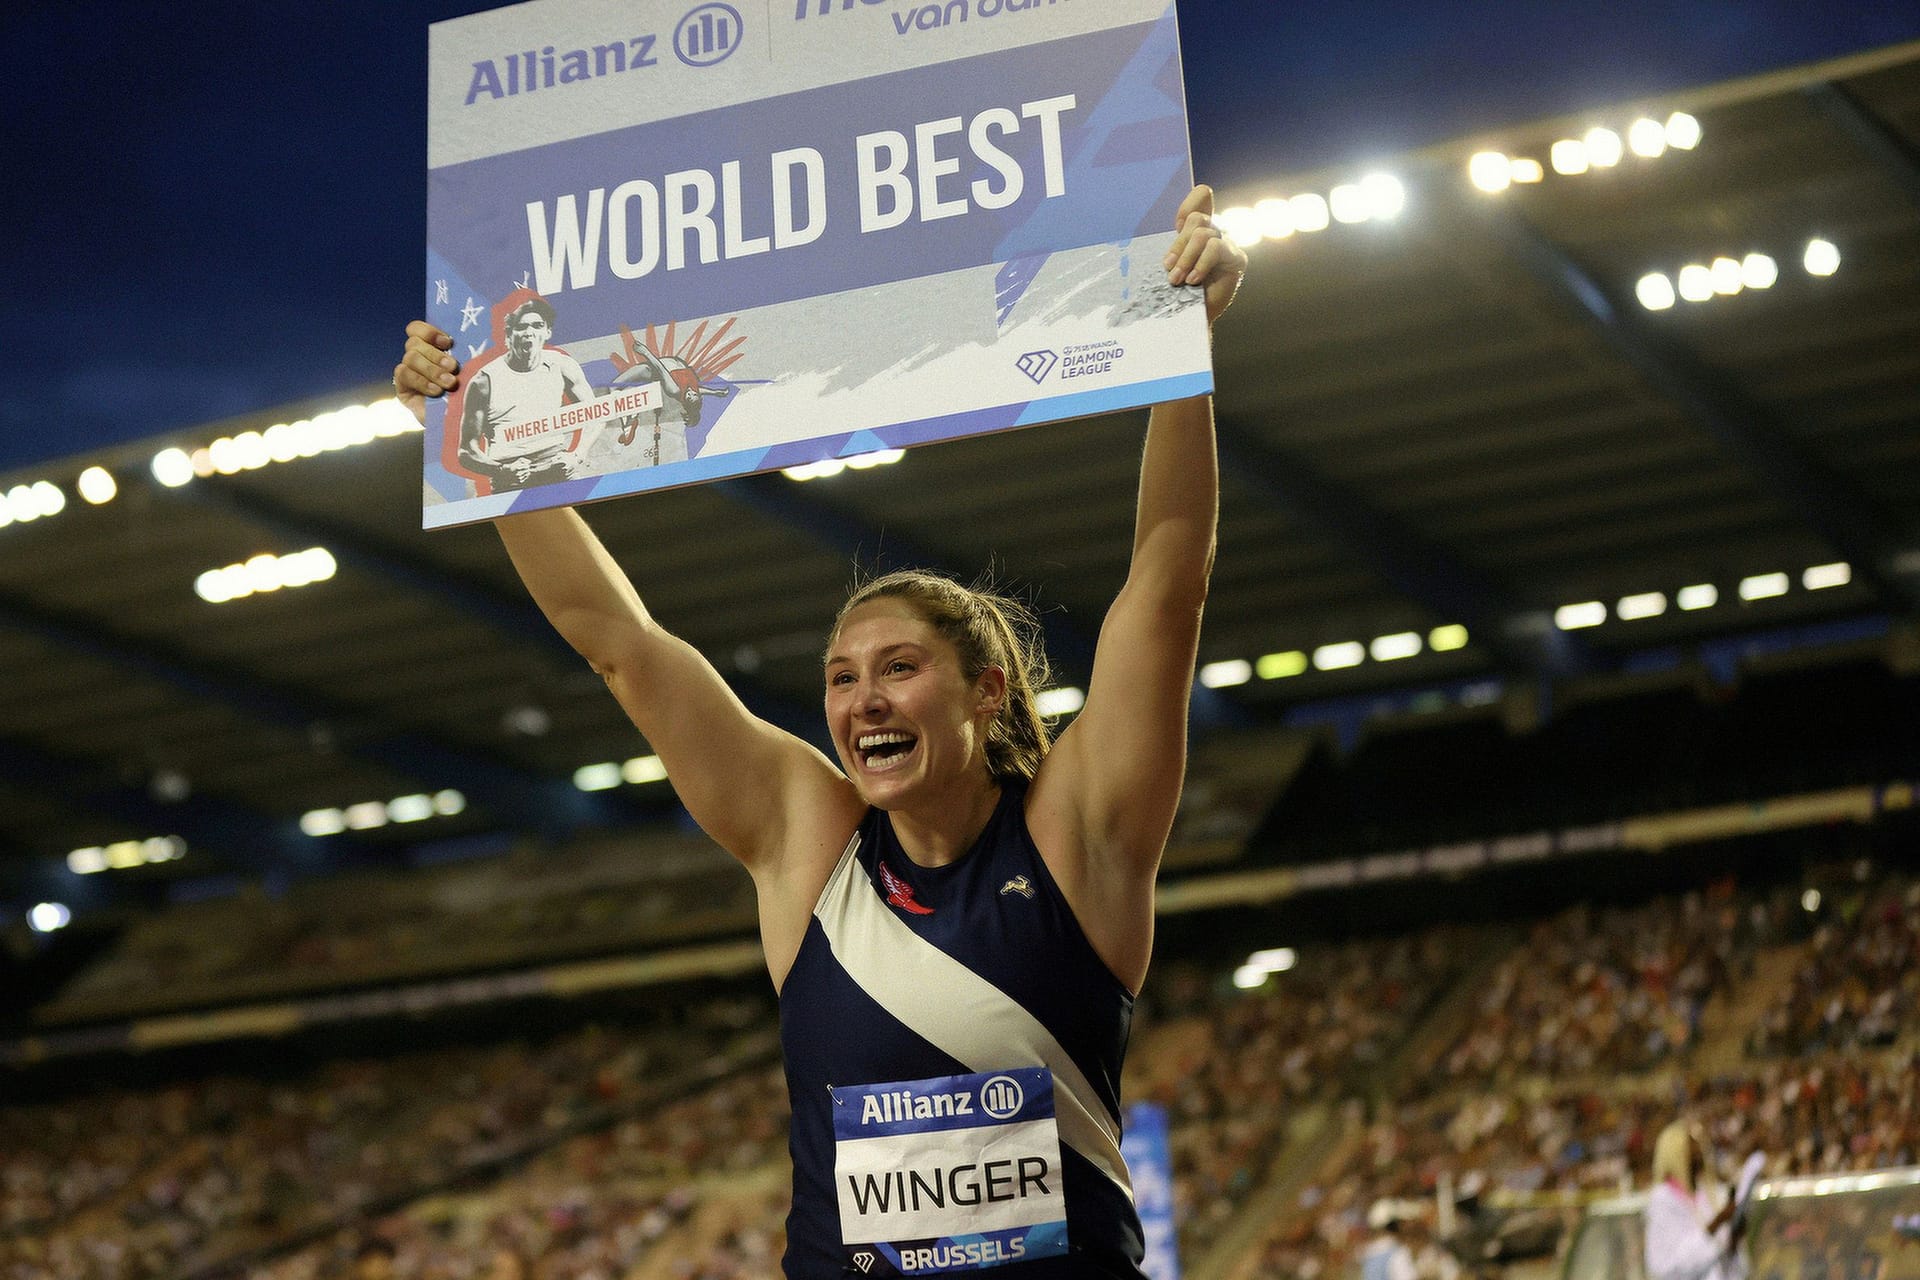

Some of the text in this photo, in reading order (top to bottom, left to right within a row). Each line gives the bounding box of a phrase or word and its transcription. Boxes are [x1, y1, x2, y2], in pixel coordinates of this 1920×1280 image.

[891, 0, 968, 35] van
[464, 34, 657, 105] Allianz
[526, 94, 1076, 296] WORLD BEST
[1061, 362, 1112, 379] LEAGUE
[1063, 348, 1124, 367] DIAMOND
[504, 391, 649, 442] WHERE LEGENDS MEET
[861, 1091, 974, 1125] Allianz
[848, 1156, 1051, 1215] WINGER
[900, 1237, 1025, 1272] BRUSSELS
